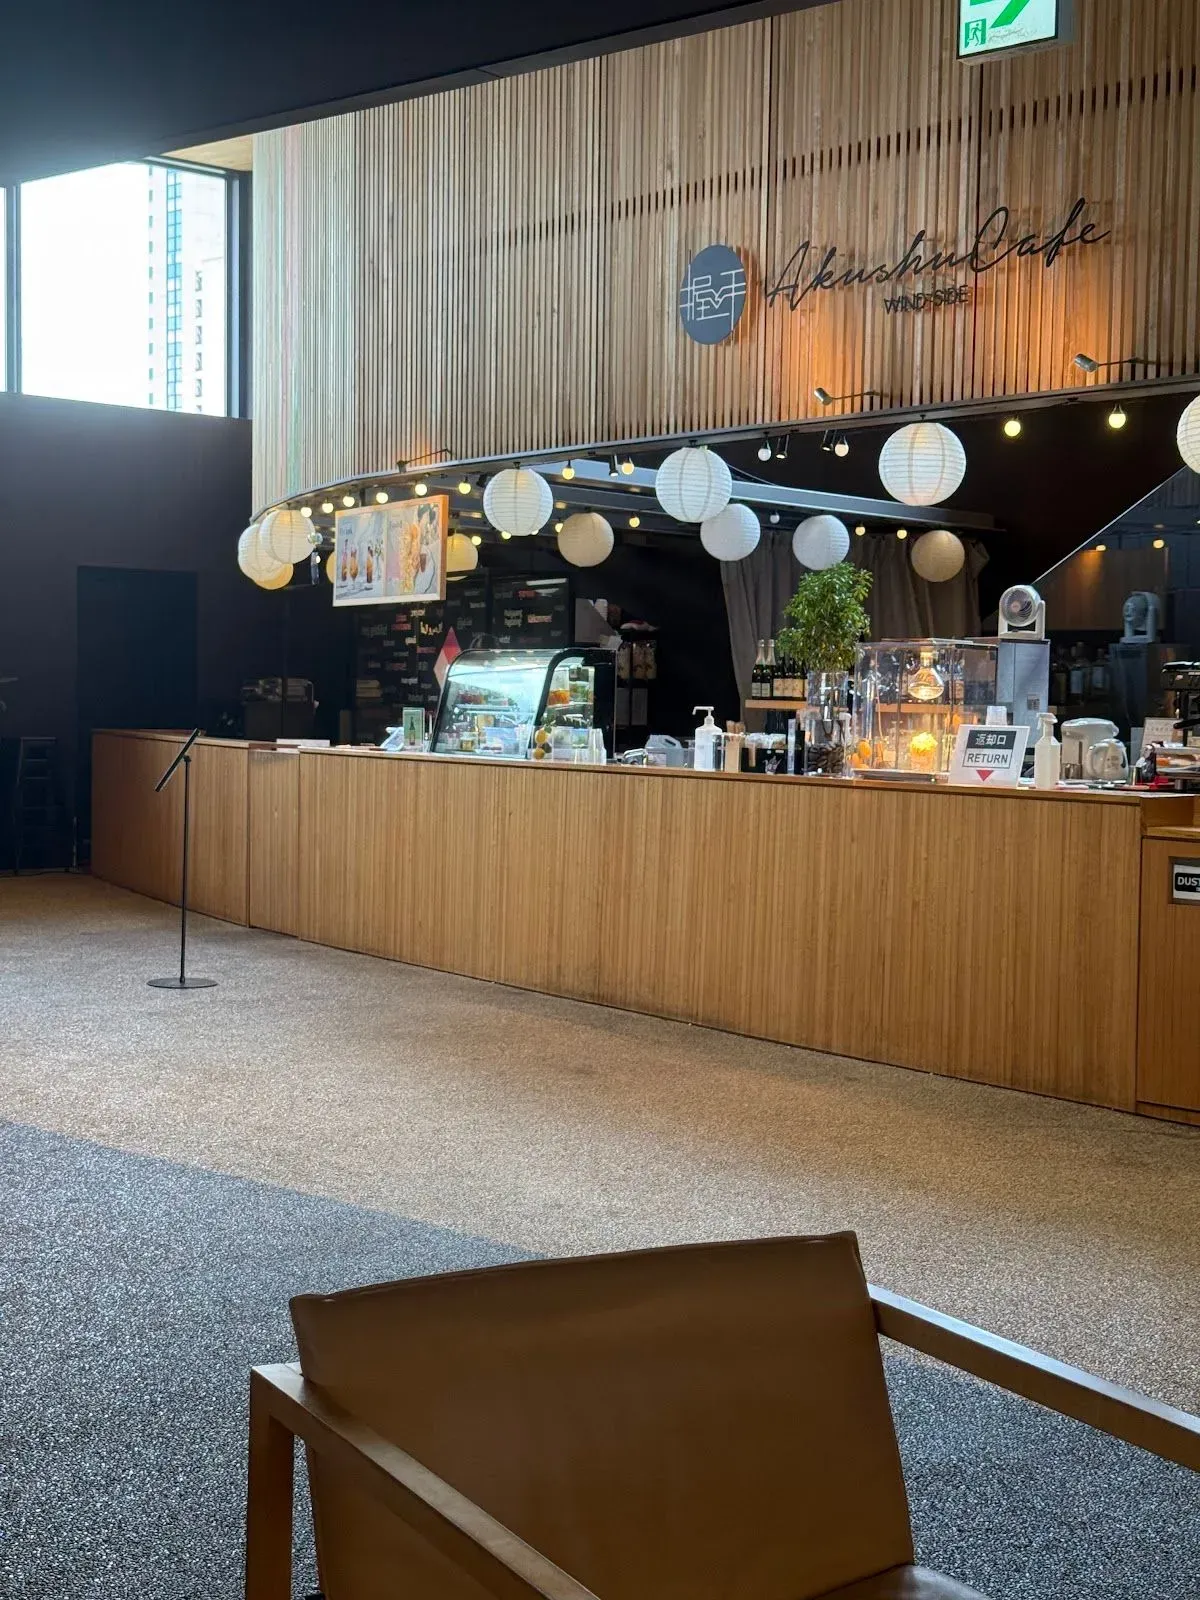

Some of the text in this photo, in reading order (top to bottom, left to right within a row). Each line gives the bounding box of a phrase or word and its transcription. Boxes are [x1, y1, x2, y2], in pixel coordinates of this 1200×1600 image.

[975, 733, 1007, 746] 返却口
[966, 753, 1009, 765] RETURN
